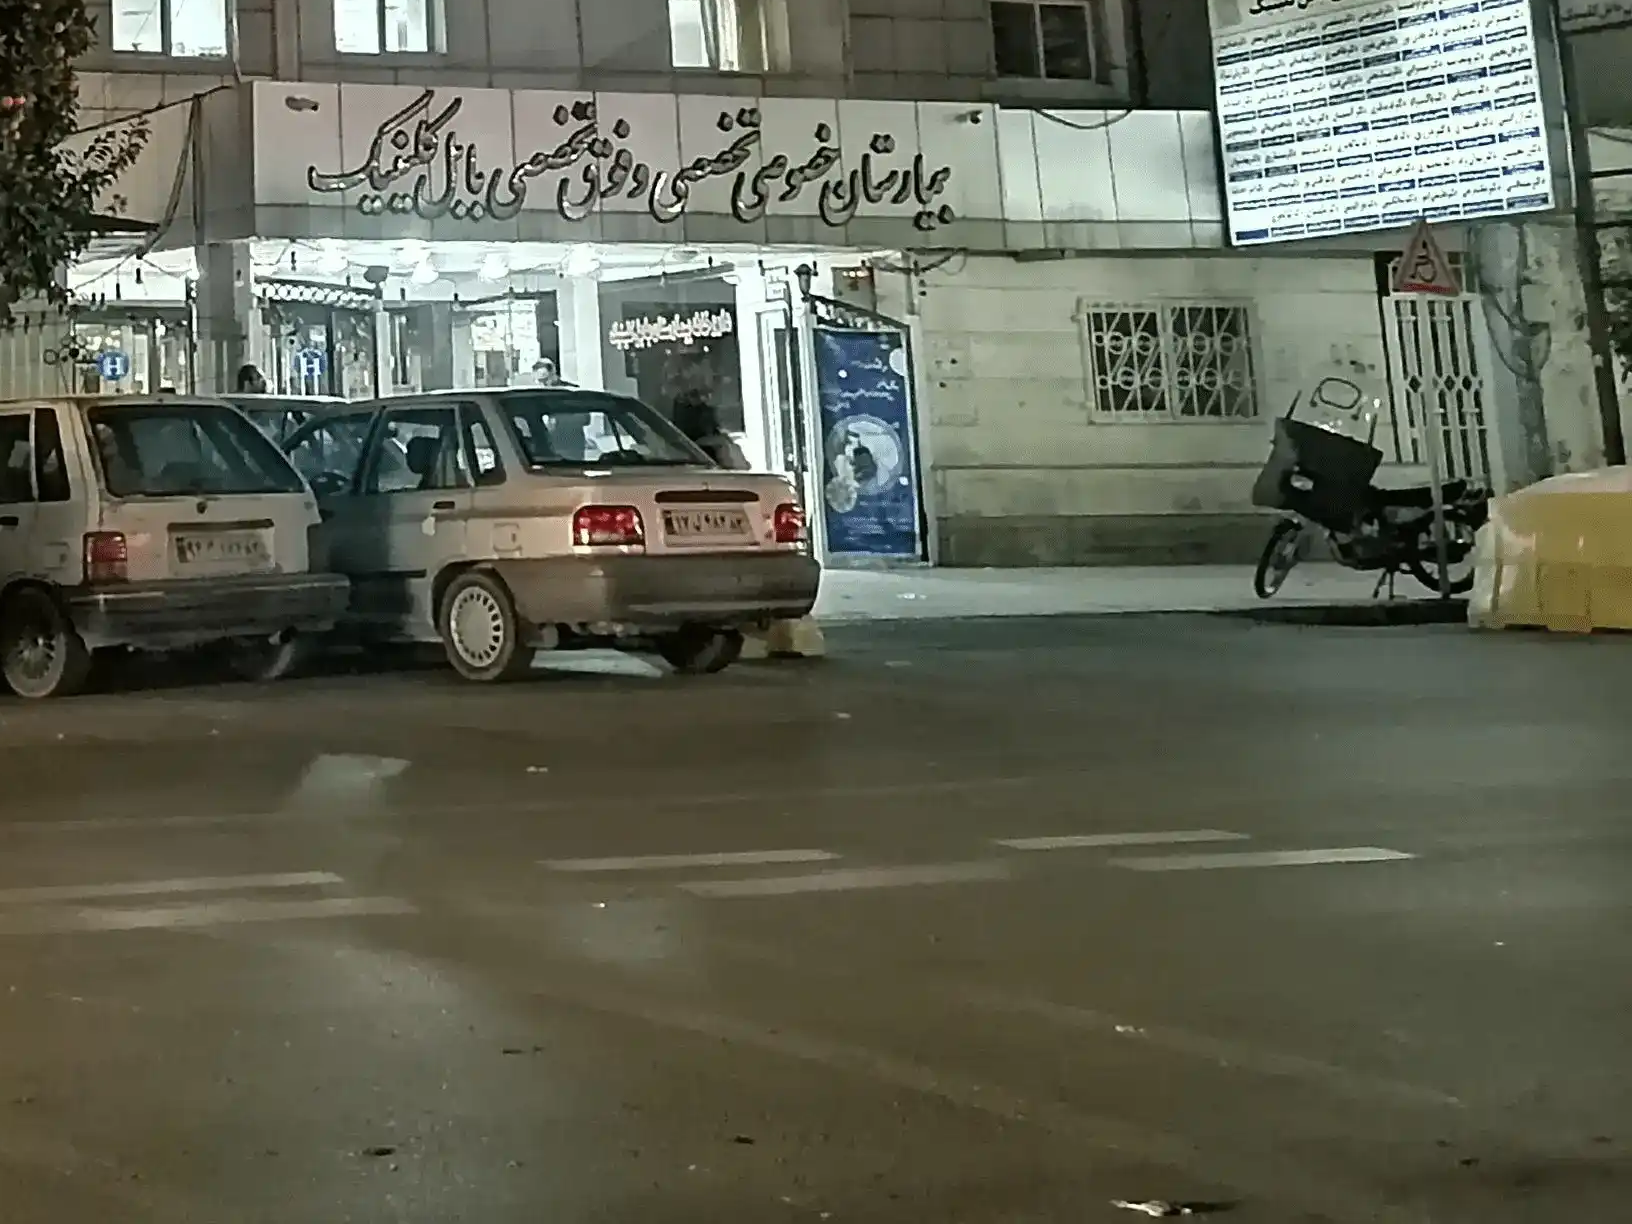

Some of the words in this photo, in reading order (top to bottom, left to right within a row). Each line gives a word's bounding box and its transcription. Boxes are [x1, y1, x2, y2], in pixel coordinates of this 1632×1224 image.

[307, 89, 463, 216] کلینیک
[413, 130, 485, 222] بابل
[486, 101, 598, 221] تخصصی
[557, 118, 633, 222] فوق
[648, 107, 762, 223] تخصصی
[731, 122, 841, 224] خصوصی
[819, 132, 955, 231] بیمارستان
